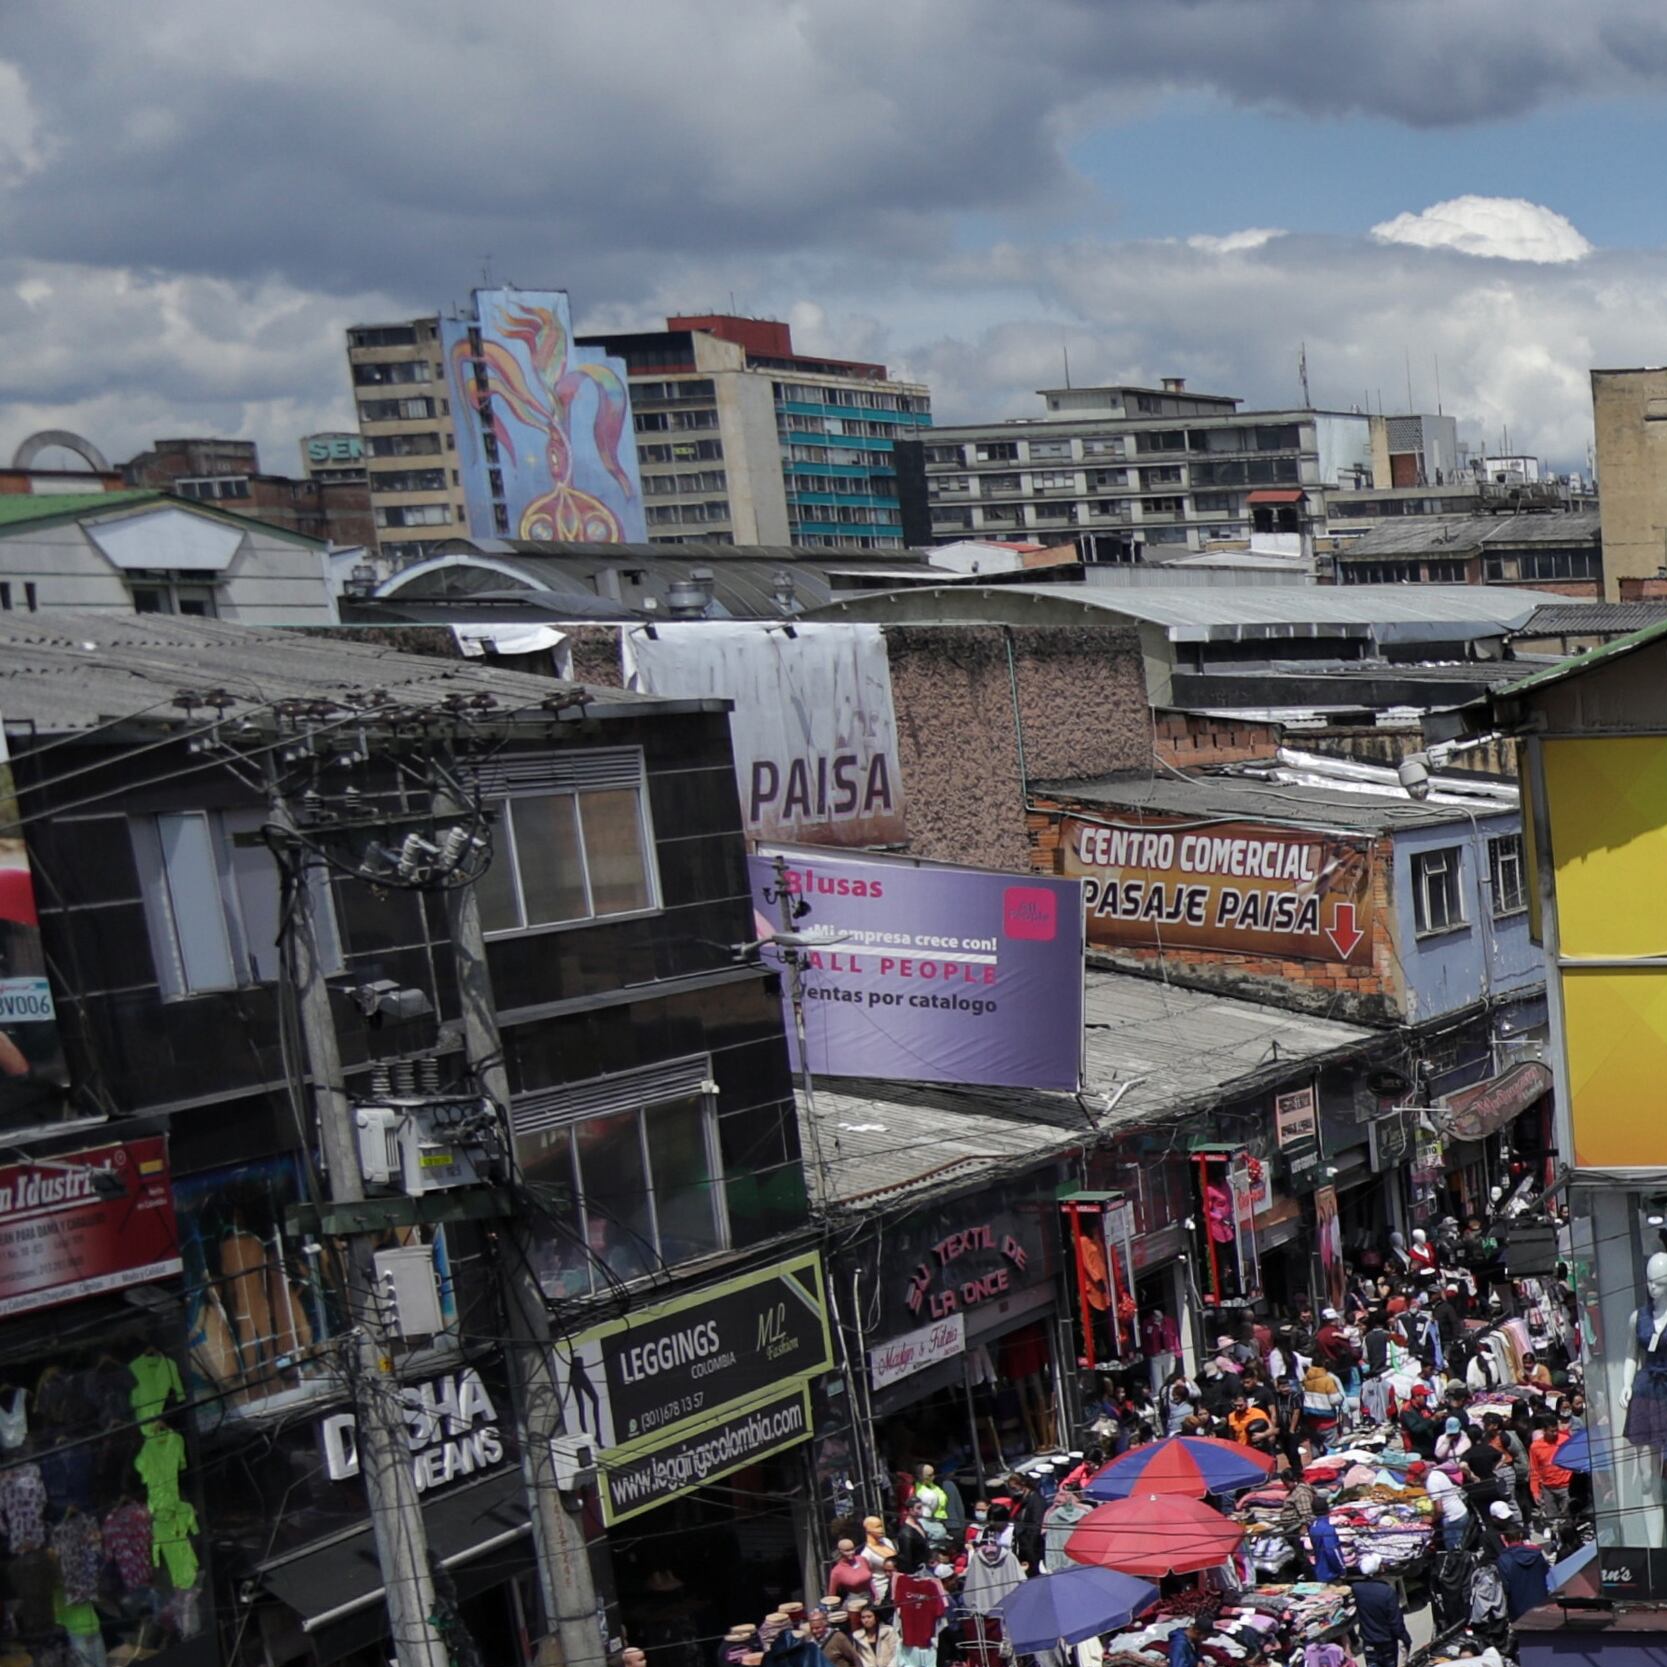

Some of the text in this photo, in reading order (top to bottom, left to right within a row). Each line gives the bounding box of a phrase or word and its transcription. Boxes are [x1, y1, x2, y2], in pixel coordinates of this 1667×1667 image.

[750, 753, 892, 821] PAISA
[1080, 827, 1314, 880] CENTRO COMERCIAL
[784, 872, 883, 898] Blusas
[1082, 879, 1320, 935] PASAJE PAISA
[809, 952, 998, 985] ALL PEOPLE
[915, 935, 958, 949] crece
[962, 935, 998, 951] con!
[868, 991, 904, 1010] por
[908, 989, 998, 1015] catalogo
[934, 1225, 995, 1267] TEXTIL
[930, 1268, 1009, 1319] LA ONCE
[620, 1320, 720, 1385] LEGGINGS
[691, 1351, 737, 1380] COLOMBIA
[323, 1367, 498, 1480] DSHA
[612, 1403, 804, 1505] www.leggingscolombia.com
